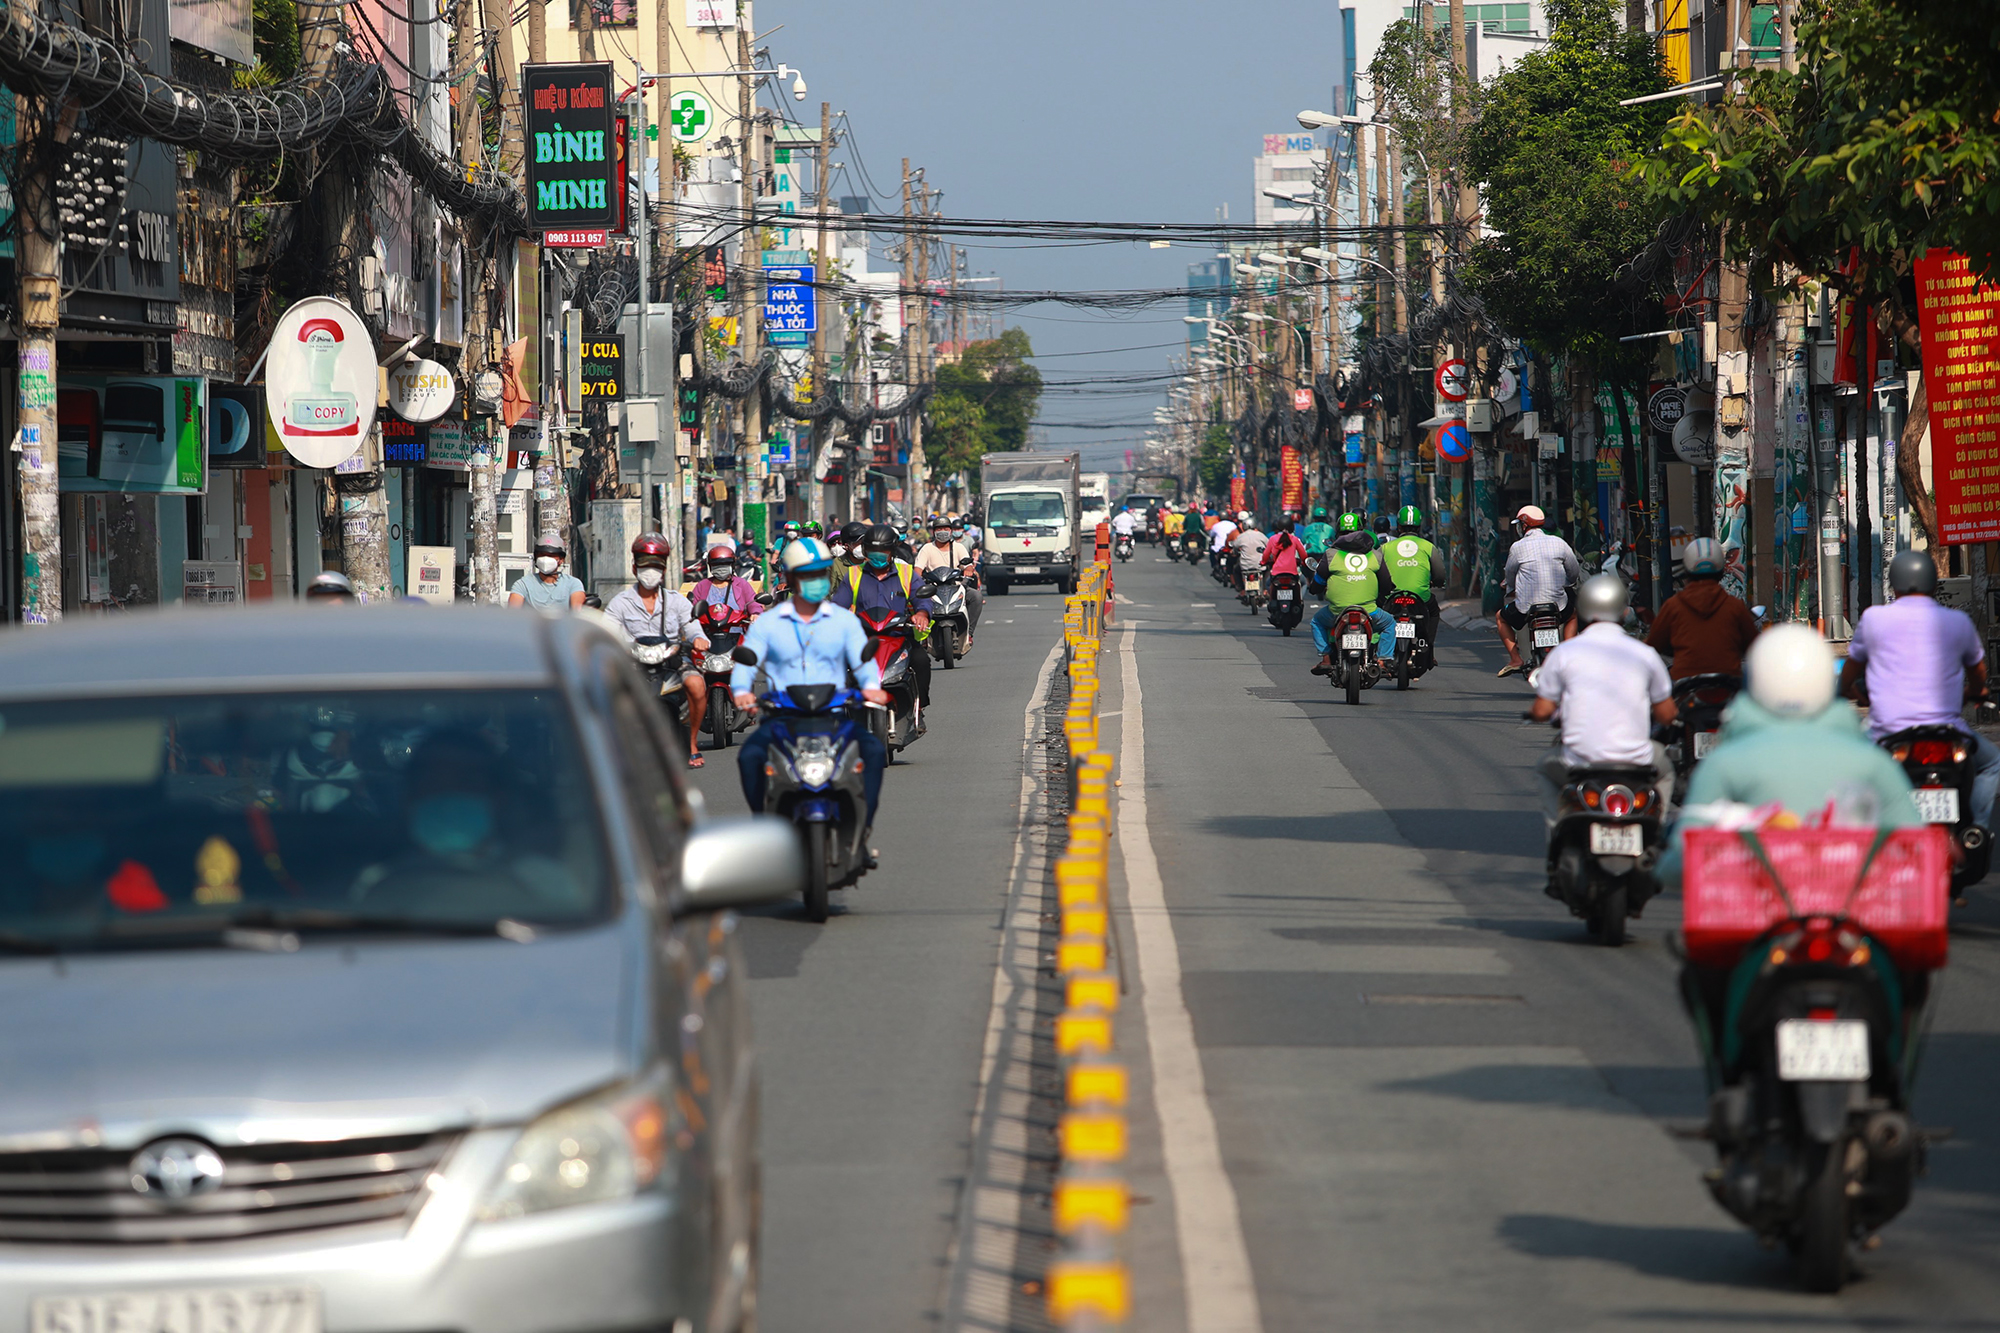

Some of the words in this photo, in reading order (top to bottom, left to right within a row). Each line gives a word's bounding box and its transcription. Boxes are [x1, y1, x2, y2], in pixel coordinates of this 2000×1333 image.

[534, 83, 567, 113] HIỆU
[570, 82, 605, 109] KÍNH
[535, 122, 605, 164] BÌNH
[1286, 136, 1313, 151] MB
[537, 178, 607, 211] MINH
[138, 210, 170, 263] STORE
[548, 233, 569, 243] 0903
[570, 233, 586, 243] 113
[587, 233, 603, 243] 057
[772, 287, 798, 300] NHÀ
[767, 301, 805, 315] THUỐC
[1964, 307, 1985, 322] HÀNH
[786, 314, 807, 329] TỐT
[1935, 329, 1959, 343] KHÔNG
[1961, 327, 1980, 342] THỰC
[592, 343, 619, 358] CUA
[1947, 343, 1969, 360] QUYẾT
[1970, 344, 1989, 358] ĐỊNH
[1945, 363, 1965, 378] DỤNG
[1966, 361, 1984, 376] BIỆN
[1946, 381, 1962, 396] TẠM
[1964, 378, 1982, 392] ĐÌNH
[182, 386, 192, 424] trodat
[1933, 400, 1951, 414] HOẠT
[1974, 394, 1989, 408] CỦA
[314, 407, 346, 418] COPY
[1660, 410, 1682, 419] PRO
[1943, 416, 1961, 431] DỊCH
[1962, 415, 1973, 429] VỤ
[1955, 431, 1976, 446] CÔNG
[1976, 429, 1997, 445] CỘNG
[385, 443, 426, 461] MINH
[1956, 447, 1967, 463] CÓ
[1967, 447, 1988, 461] NGUY
[1949, 466, 1966, 480] LÀM
[1961, 483, 1981, 499] BỆNH
[1982, 482, 1999, 496] DỊCH
[1962, 501, 1982, 514] VÙNG
[1397, 559, 1418, 567] Grab
[1346, 574, 1367, 582] gojek
